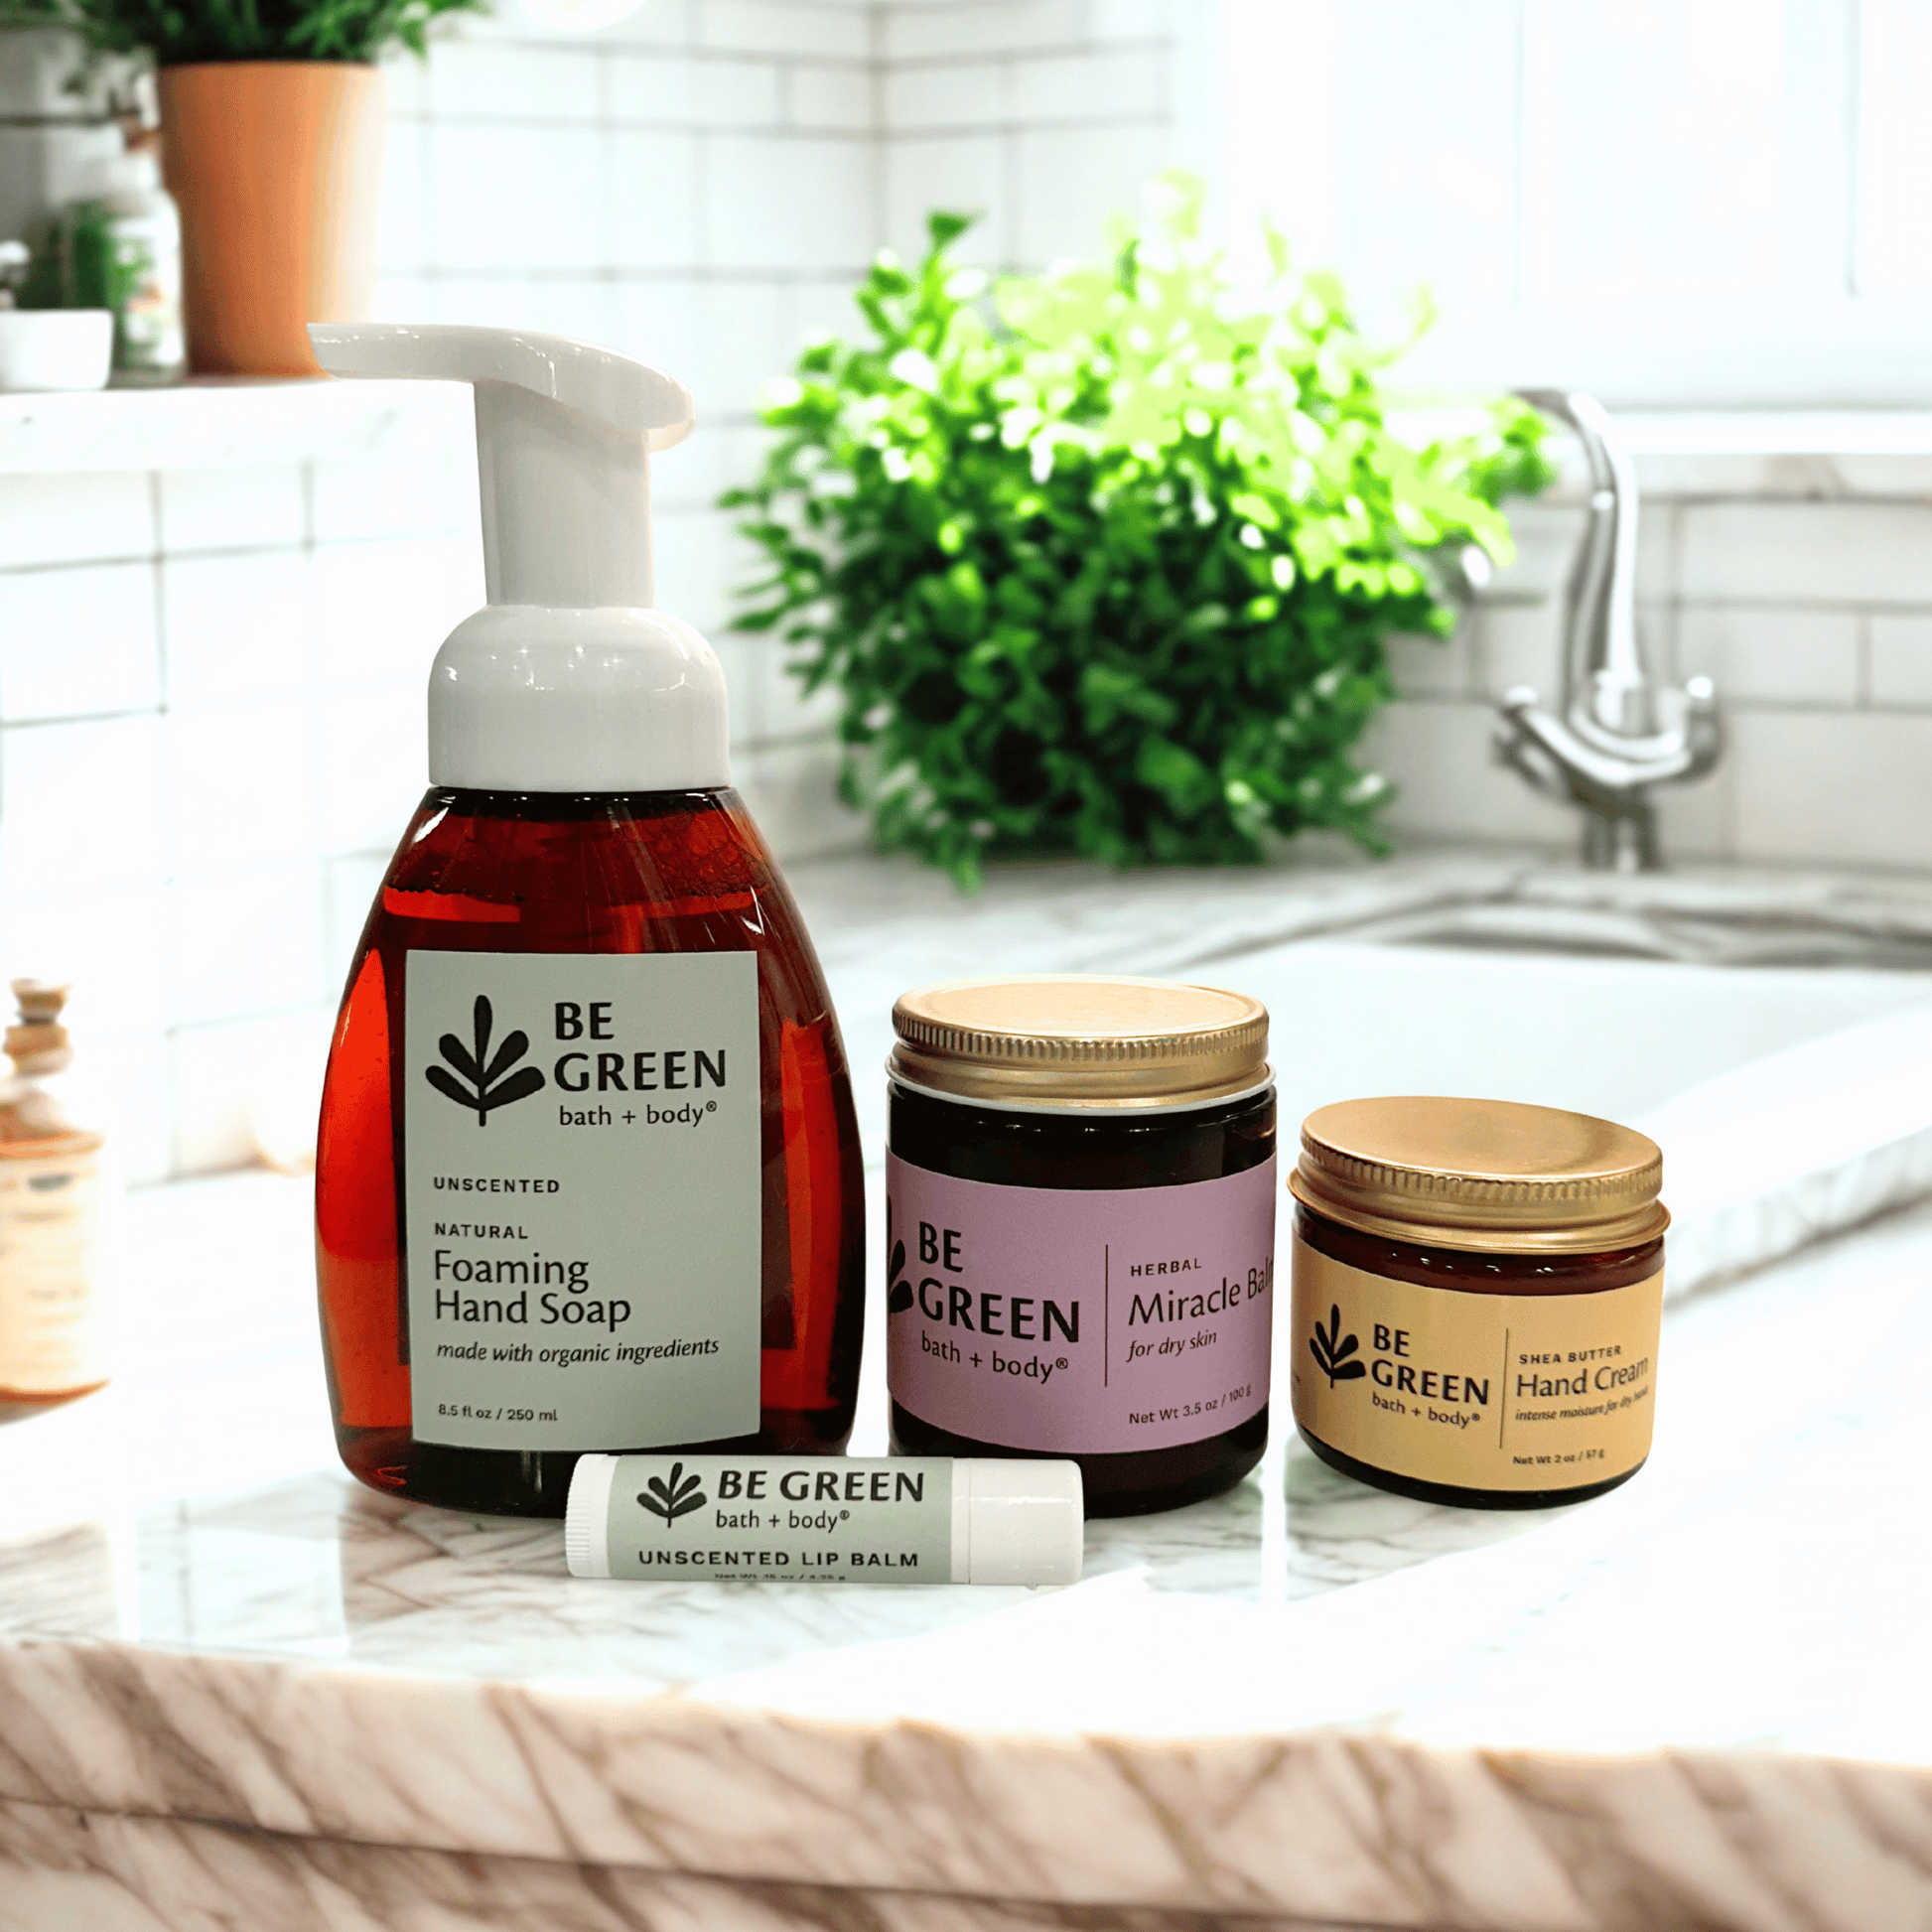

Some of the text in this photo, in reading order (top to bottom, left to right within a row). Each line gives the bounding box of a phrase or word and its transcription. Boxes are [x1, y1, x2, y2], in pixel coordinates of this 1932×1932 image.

[554, 1001, 615, 1041] BE
[553, 1048, 726, 1092] GREEN
[559, 1104, 612, 1126] bath
[621, 1110, 636, 1125] +
[433, 1176, 560, 1193] UNSCENTED
[434, 1222, 528, 1240] NATURAL
[918, 1220, 964, 1274] BE
[434, 1249, 590, 1294] Foaming
[1130, 1258, 1201, 1277] HERBAL
[435, 1288, 631, 1333] Hand Soap
[917, 1277, 1080, 1343] GREEN
[1128, 1276, 1241, 1326] Miracle
[437, 1338, 720, 1368] made with organic ingredients
[920, 1329, 961, 1364] bath
[969, 1352, 983, 1368] +
[1126, 1329, 1217, 1363] for dry skin
[1373, 1322, 1410, 1358] BE
[1519, 1344, 1621, 1365] SHEA BUTTER
[1371, 1358, 1489, 1406] GREEN
[1516, 1356, 1649, 1398] Hand Cream
[438, 1403, 558, 1422] 8.5 fl oz / 250 ml
[1129, 1412, 1155, 1425] Net
[1159, 1408, 1178, 1421] Wt
[1182, 1402, 1202, 1417] 3.5
[1204, 1399, 1218, 1412] oz
[1220, 1393, 1227, 1408] /
[1228, 1386, 1245, 1403] 100
[1371, 1391, 1406, 1415] bath
[1411, 1407, 1422, 1417] +
[1514, 1411, 1558, 1422] intense
[1559, 1404, 1604, 1419] moisture
[1602, 1398, 1619, 1416] for
[1512, 1455, 1534, 1465] Net
[1536, 1455, 1552, 1464] Wt
[1554, 1453, 1562, 1464] 2
[718, 1469, 924, 1503] BE GREEN
[716, 1509, 759, 1529] bath
[768, 1514, 780, 1528] +
[638, 1551, 918, 1568] UNSCENTED LIP BALM
